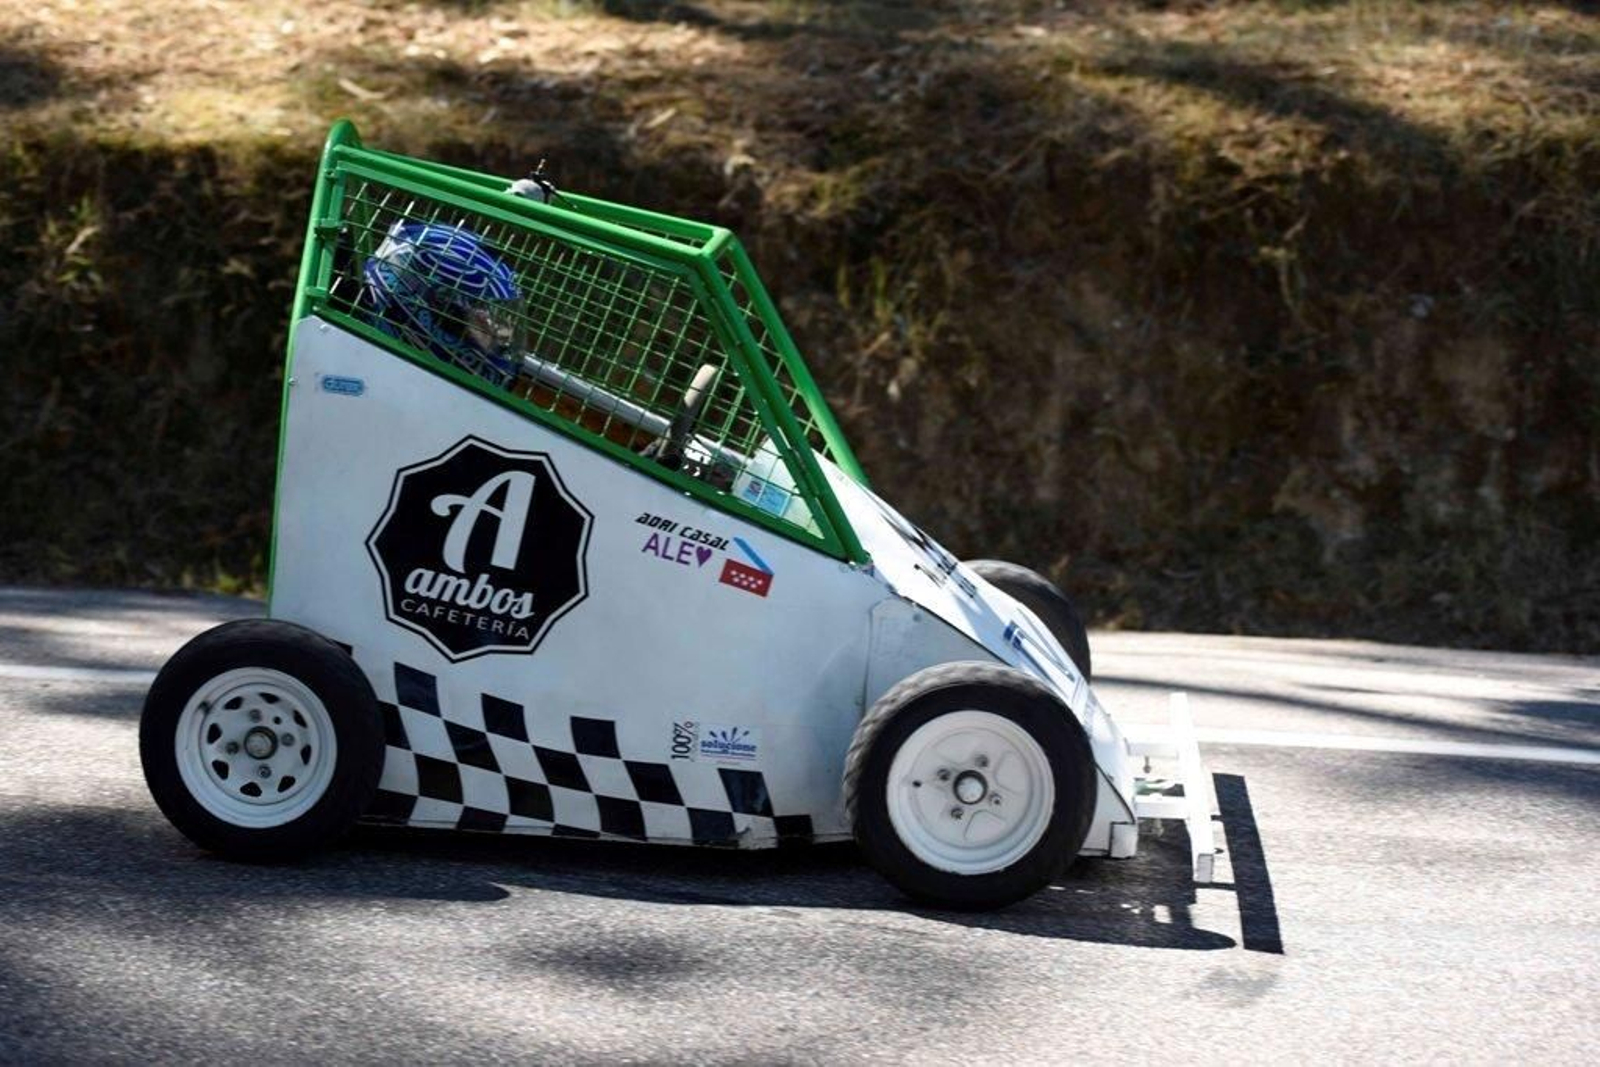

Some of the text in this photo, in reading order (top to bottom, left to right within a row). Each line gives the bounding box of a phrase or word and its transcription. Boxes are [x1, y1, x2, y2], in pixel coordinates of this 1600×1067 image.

[430, 470, 536, 574] A
[641, 532, 695, 566] ALE
[404, 567, 536, 620] ambos
[400, 598, 530, 640] CAFETERÍA
[671, 720, 694, 760] 100%
